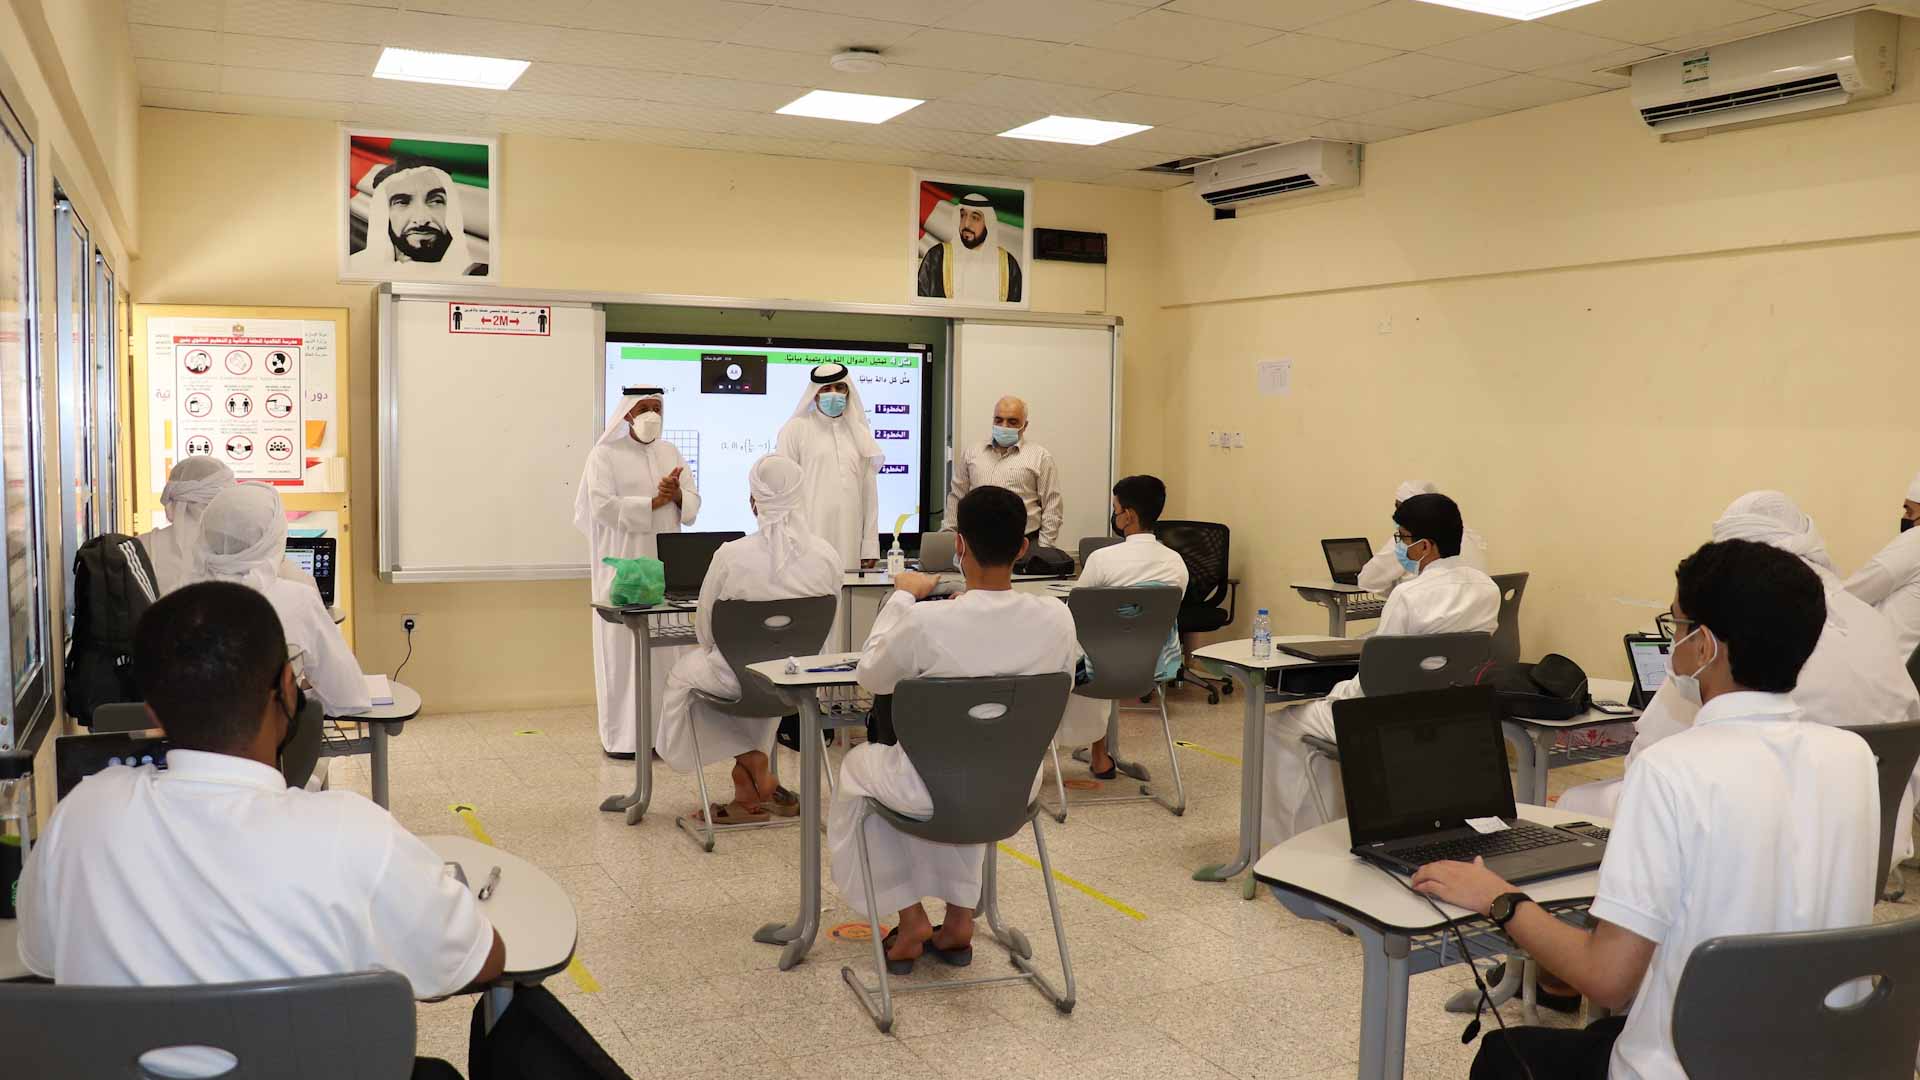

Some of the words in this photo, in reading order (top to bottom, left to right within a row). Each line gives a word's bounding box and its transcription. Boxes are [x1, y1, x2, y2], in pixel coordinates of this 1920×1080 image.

[493, 315, 508, 326] 2M
[882, 404, 905, 414] الخطوة
[882, 430, 905, 440] الخطوة
